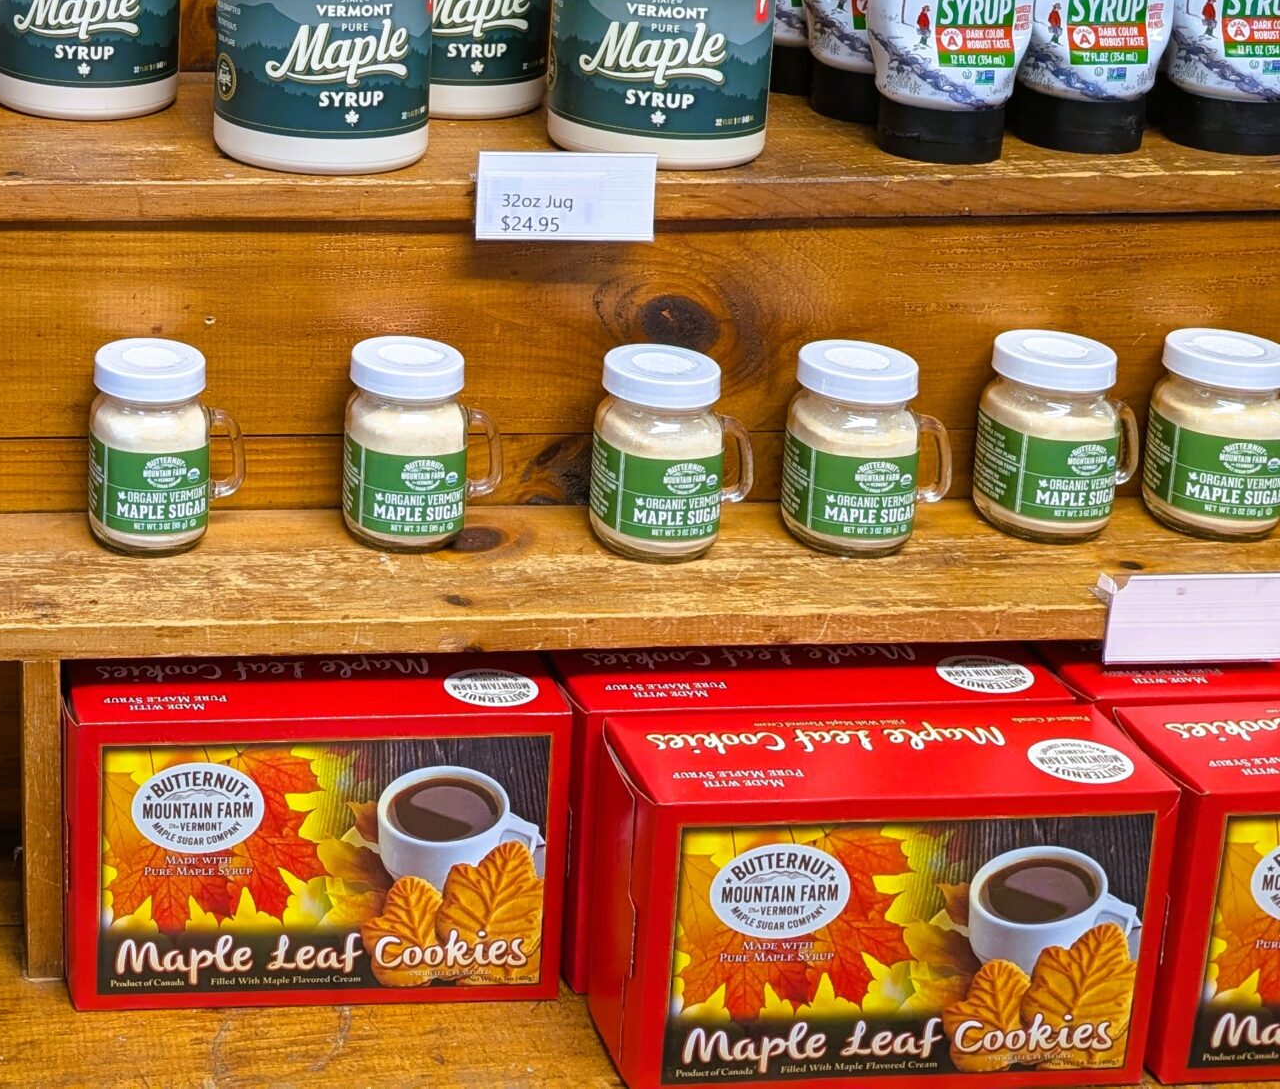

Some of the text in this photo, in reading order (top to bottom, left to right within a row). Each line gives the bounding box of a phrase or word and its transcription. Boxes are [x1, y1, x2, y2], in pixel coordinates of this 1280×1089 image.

[315, 3, 392, 17] VERMONT
[625, 2, 707, 19] VERMONT
[340, 23, 368, 32] PURE
[650, 23, 679, 33] PURE
[965, 29, 1004, 40] DARK COLOR
[54, 44, 115, 60] SYRUP
[264, 19, 407, 84] Maple
[578, 19, 727, 84] Maple
[966, 39, 1010, 50] ROBUST TASTE
[318, 90, 384, 108] SYRUP
[625, 89, 694, 109] SYRUP
[502, 193, 540, 208] 32oz
[501, 215, 560, 233] $24.95
[128, 487, 208, 504] ORGANIC VERMONT
[116, 502, 165, 519] MAPLE
[646, 720, 1006, 754] Maple Leaf Cookies
[150, 771, 249, 798] BUTTERNUT
[142, 802, 253, 819] MOUNTAIN FARM
[152, 820, 242, 847] MAPLE SUGAR COMPANY
[180, 822, 223, 832] VERMONT
[116, 930, 527, 985] Maple Leaf Cookies
[110, 978, 185, 988] Product of Canada
[210, 974, 362, 988] Filled With Maple Flavored Cream
